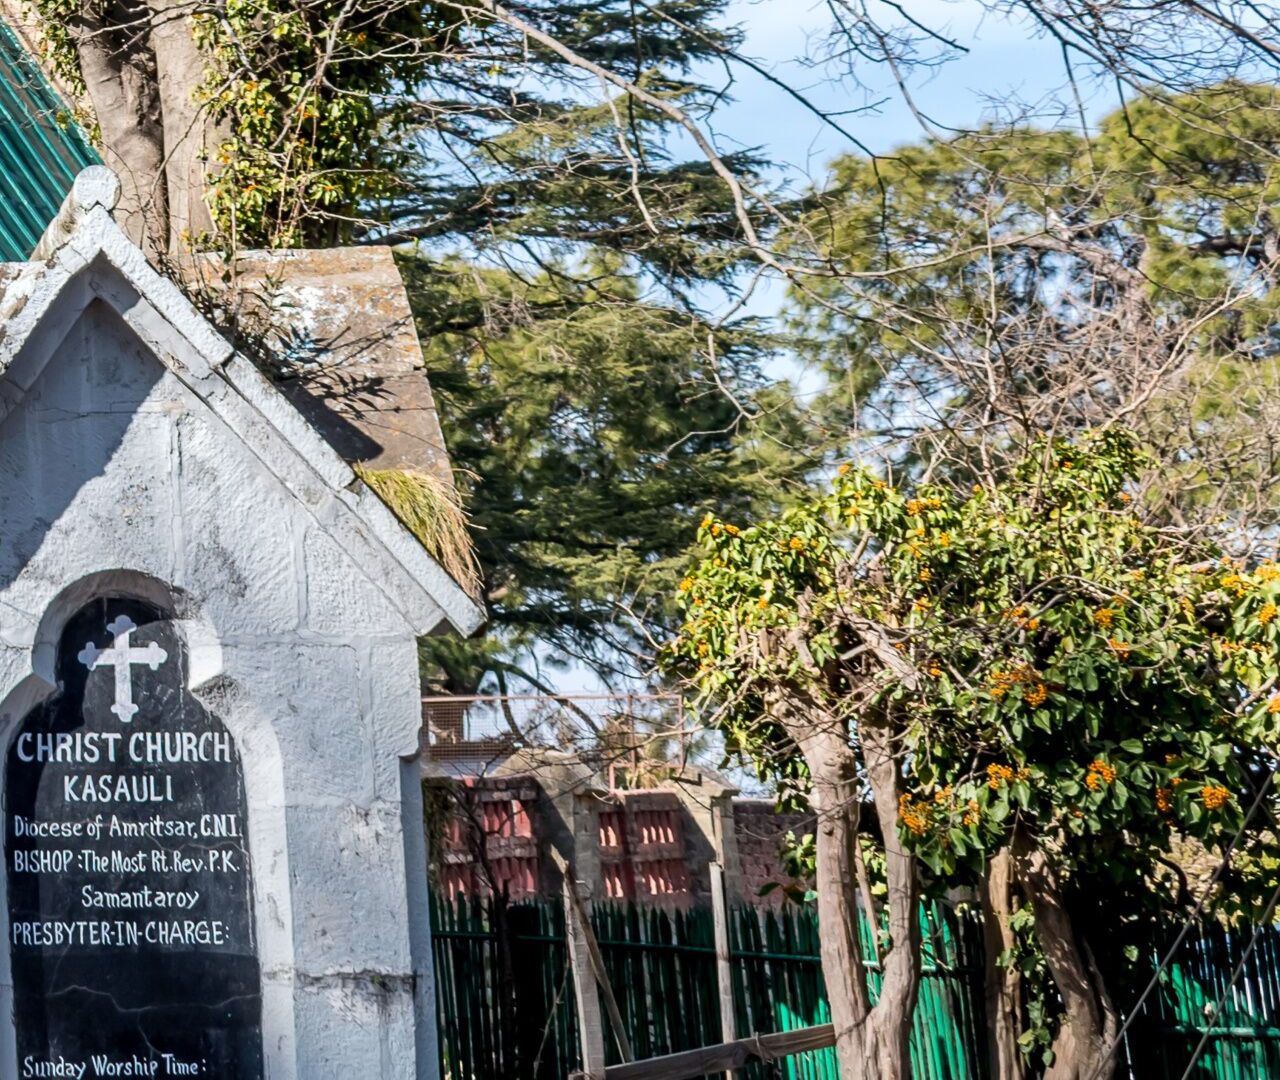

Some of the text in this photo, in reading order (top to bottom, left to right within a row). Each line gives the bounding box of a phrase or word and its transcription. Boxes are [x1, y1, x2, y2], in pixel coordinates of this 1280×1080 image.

[17, 731, 232, 763] CHRIST CHURCH
[63, 774, 174, 803] KASAULI
[14, 815, 83, 837] Diocese
[86, 814, 104, 840] of
[108, 814, 198, 839] Amritsar,
[14, 849, 74, 873] BISHOP
[111, 849, 147, 873] Most
[23, 1055, 86, 1080] Sunday
[91, 1054, 158, 1077] Worship
